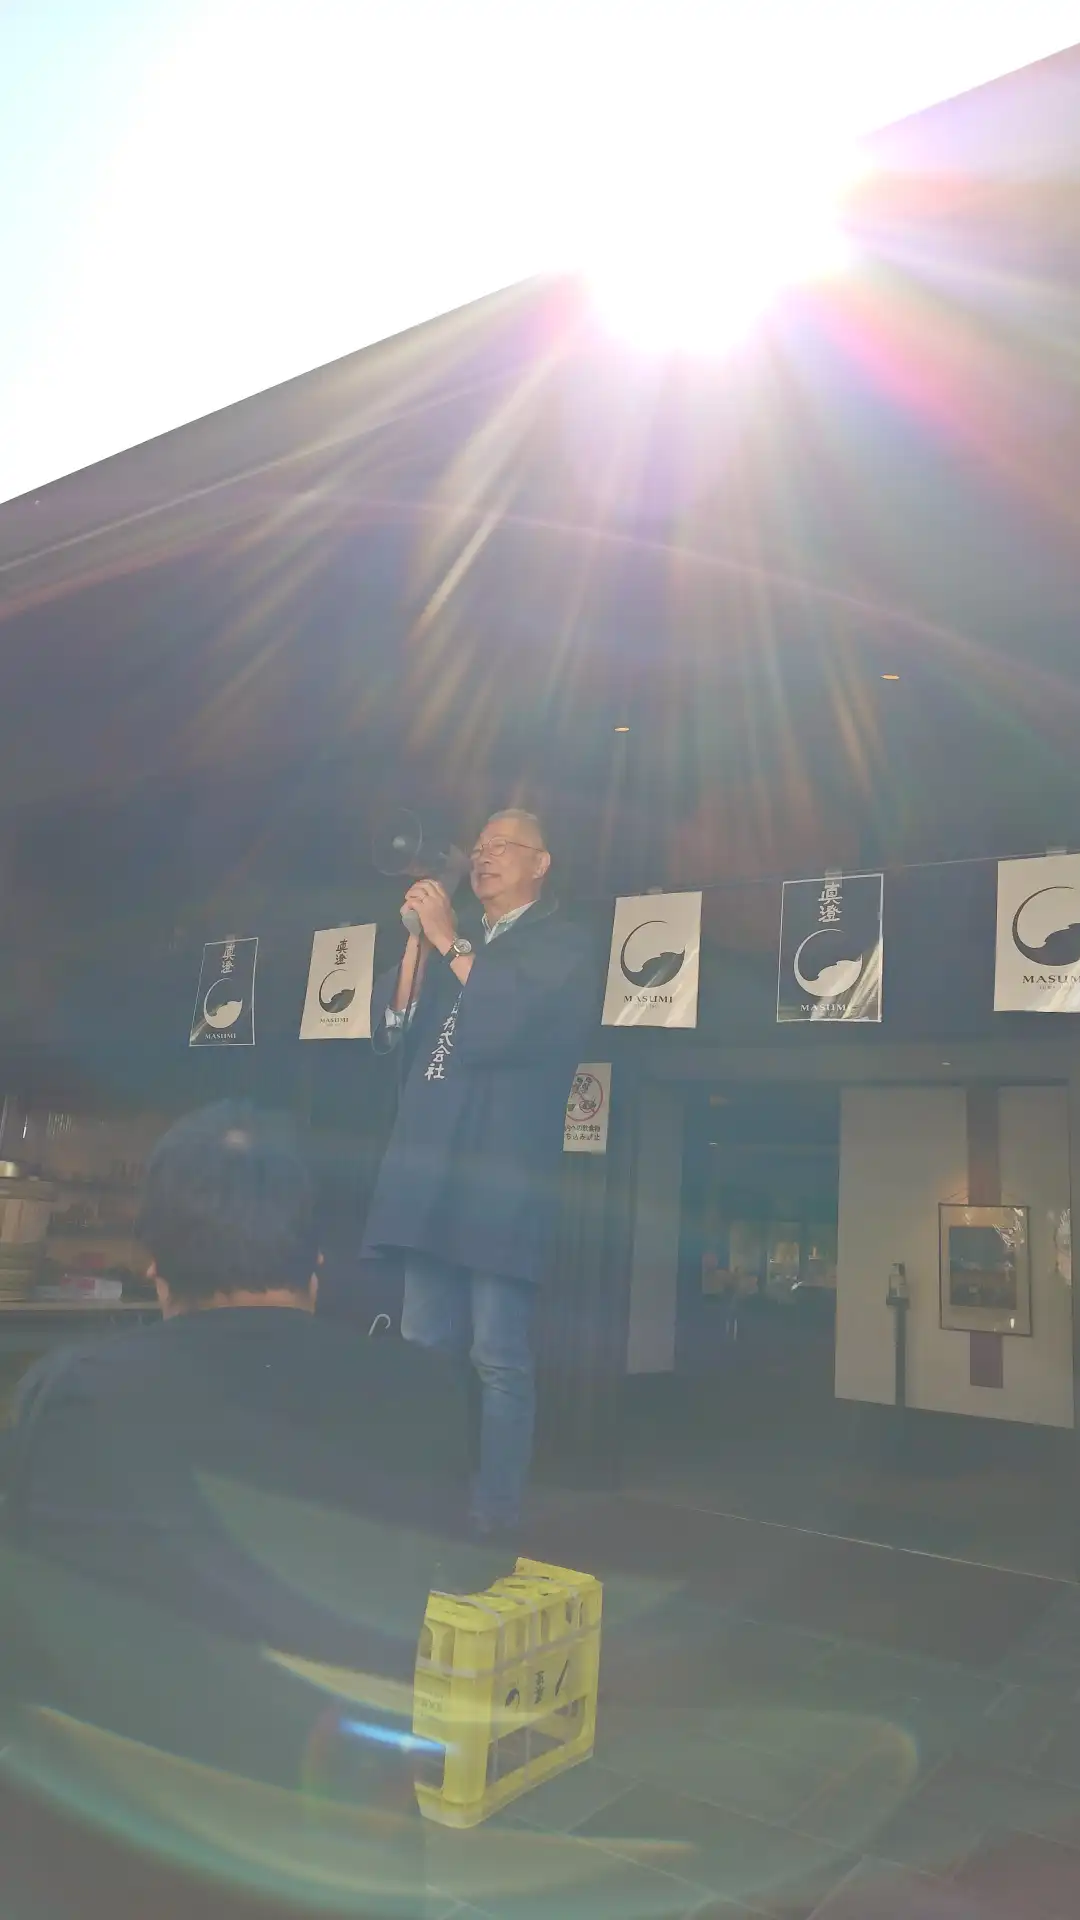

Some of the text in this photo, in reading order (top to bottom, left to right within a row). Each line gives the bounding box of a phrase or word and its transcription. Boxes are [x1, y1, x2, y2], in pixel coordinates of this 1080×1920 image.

[623, 995, 673, 1004] MASUMI
[800, 1004, 850, 1012] MASUM
[204, 1032, 237, 1040] MASUMI
